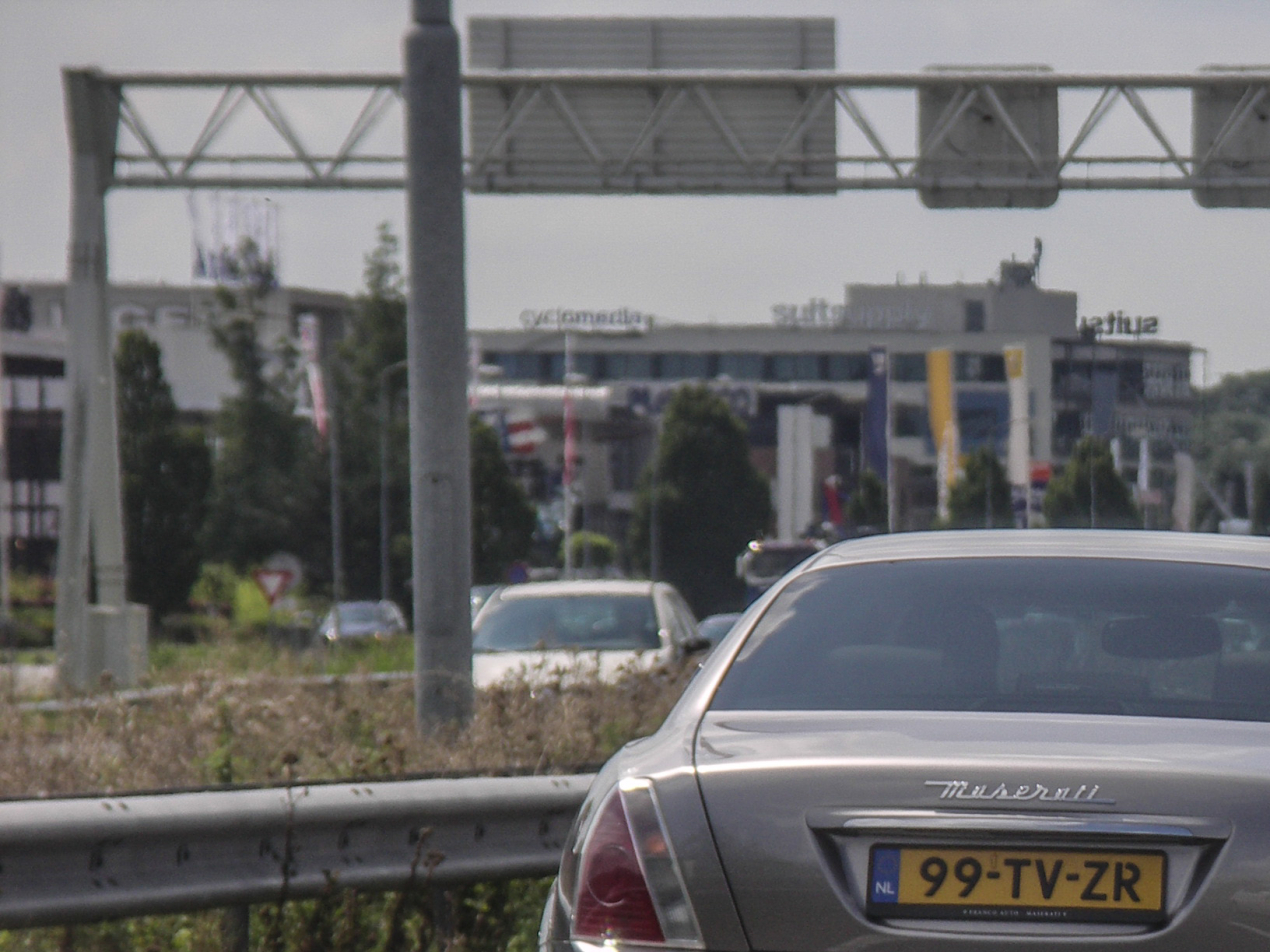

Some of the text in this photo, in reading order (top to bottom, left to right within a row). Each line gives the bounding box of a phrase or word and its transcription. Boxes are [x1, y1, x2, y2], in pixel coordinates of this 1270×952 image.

[924, 779, 1116, 805] Maserati
[875, 881, 895, 895] NL
[919, 856, 1141, 903] 99-TV-ZR
